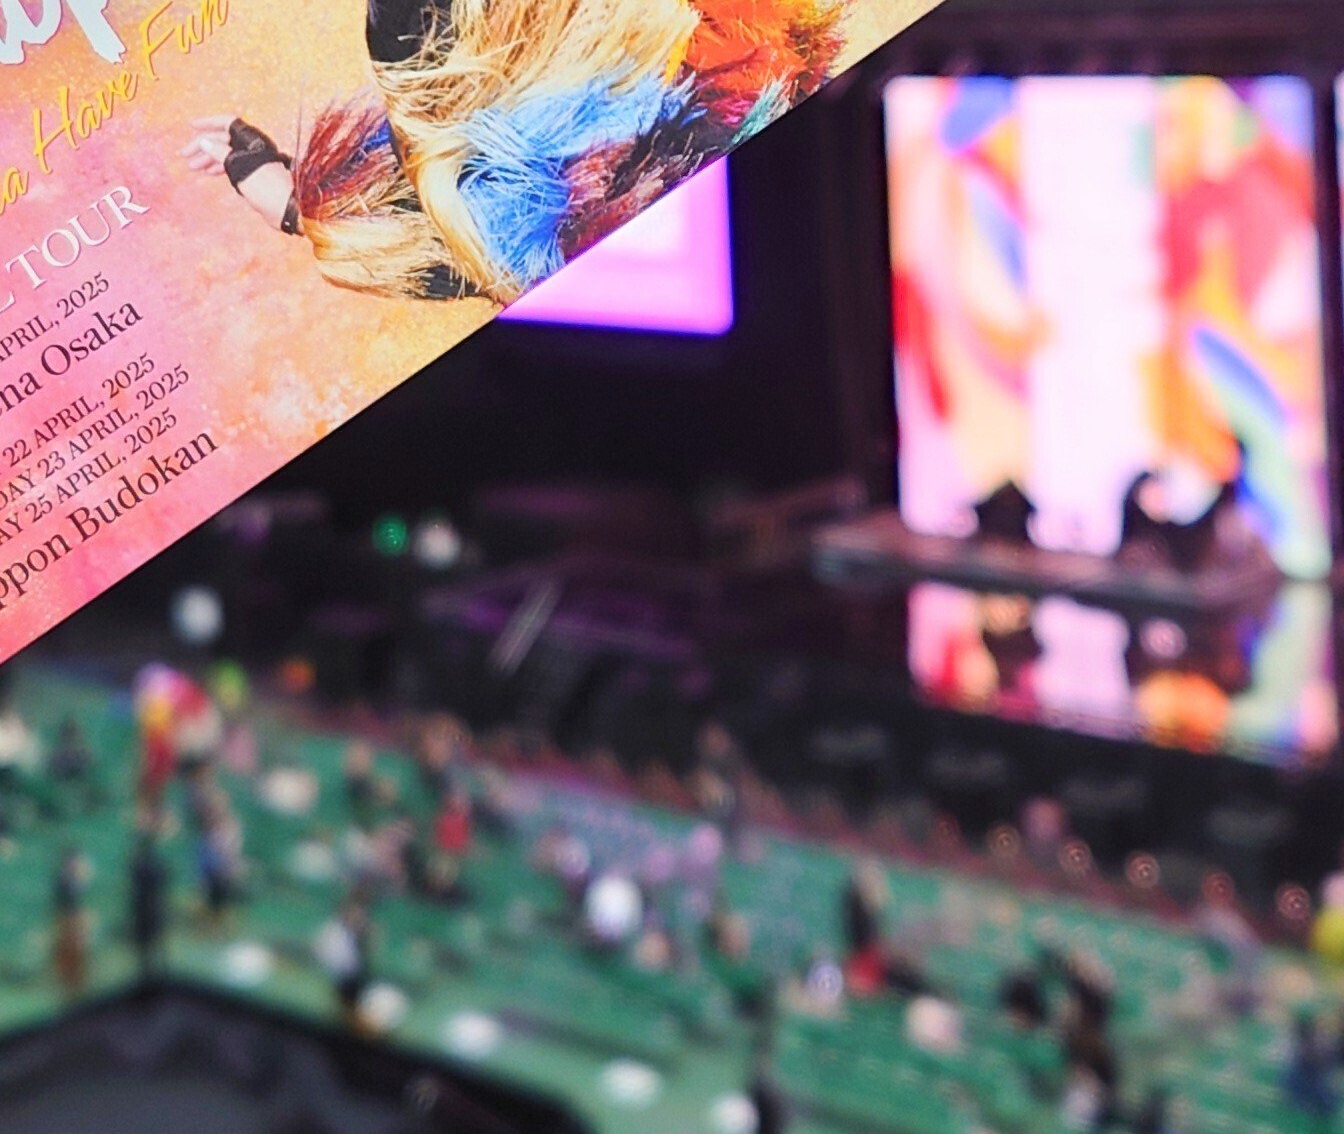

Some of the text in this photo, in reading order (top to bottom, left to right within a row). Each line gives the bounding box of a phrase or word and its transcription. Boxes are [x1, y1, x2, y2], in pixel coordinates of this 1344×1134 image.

[33, 70, 138, 174] Have
[6, 185, 151, 290] TOUR
[40, 302, 144, 377] Osaka
[56, 271, 110, 319] 2025
[2, 438, 32, 468] 22
[32, 395, 106, 450] APRIL,
[101, 352, 156, 399] 2025
[37, 449, 67, 480] 23
[67, 406, 141, 463] APRIL,
[136, 363, 190, 411] 2025
[24, 493, 53, 524] 25
[55, 452, 129, 505] APRIL,
[124, 406, 179, 455] 2025
[66, 431, 220, 543] Budokan
